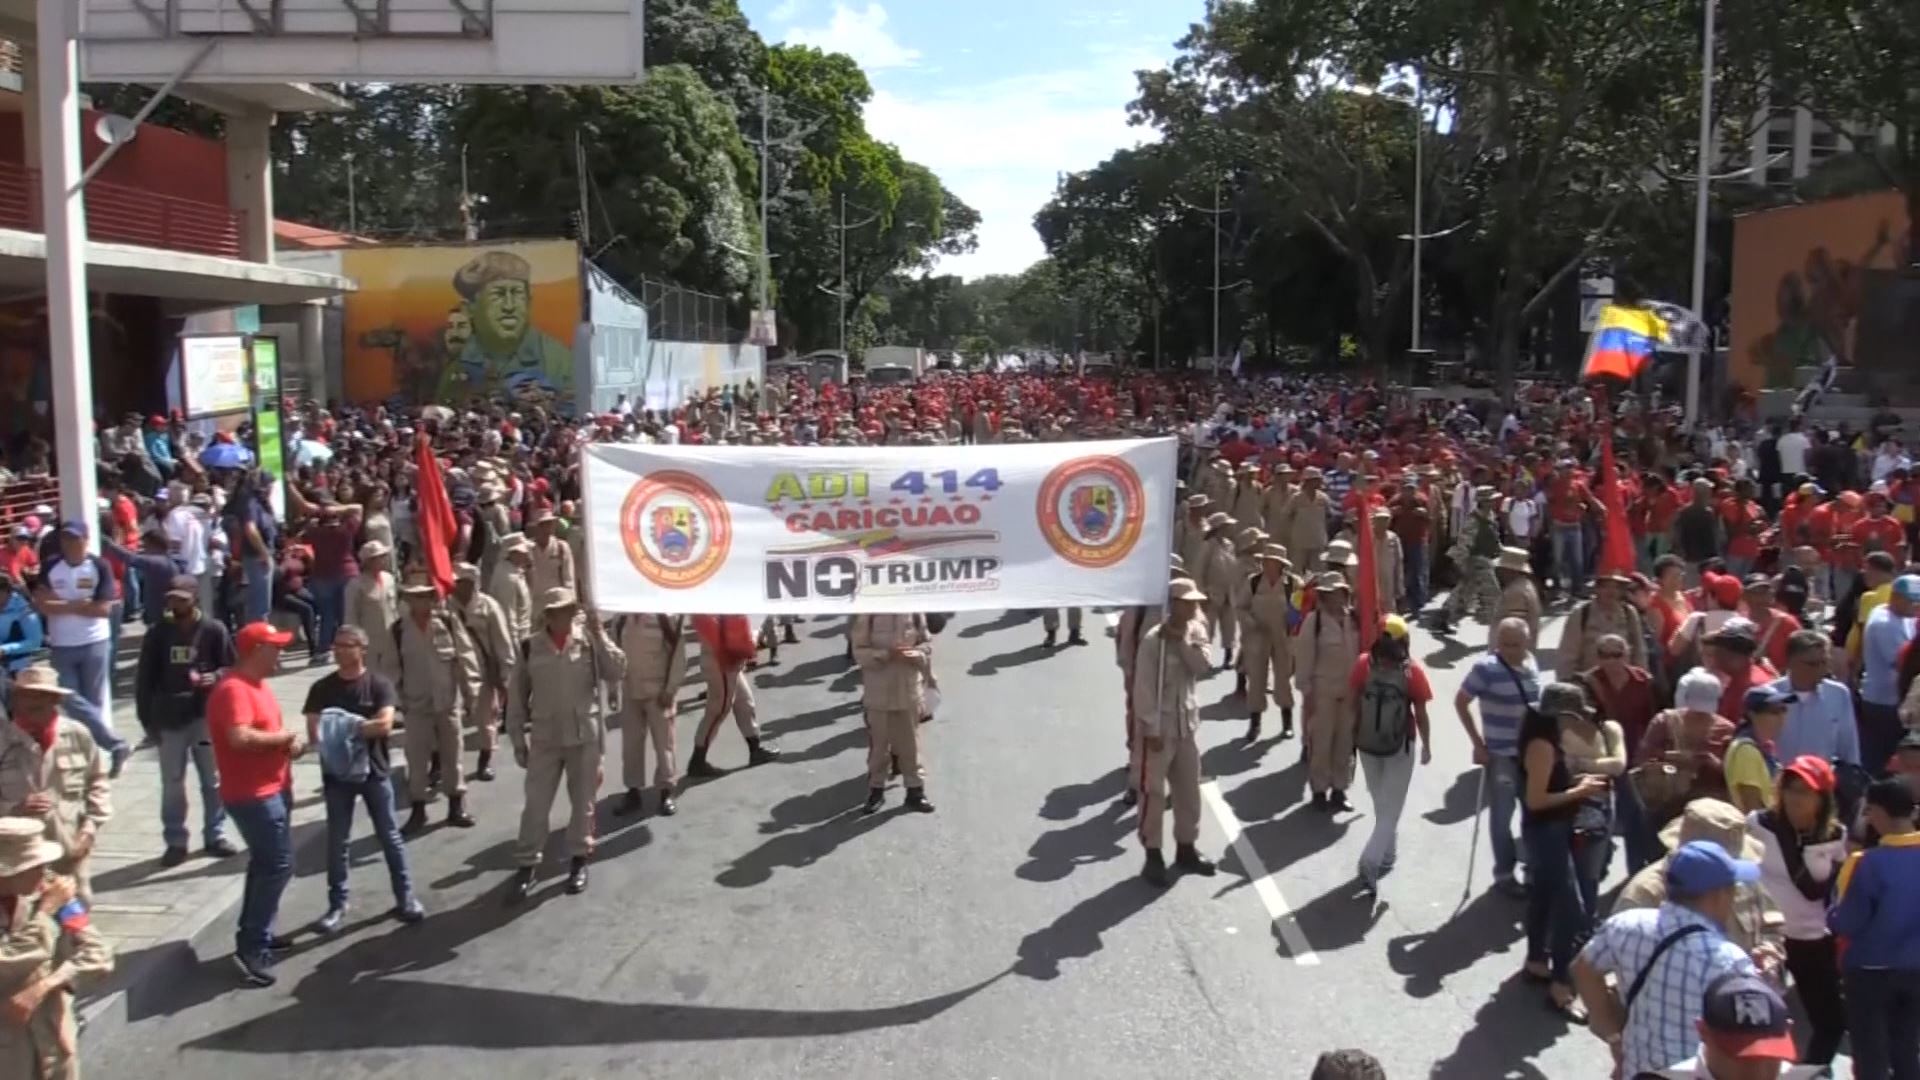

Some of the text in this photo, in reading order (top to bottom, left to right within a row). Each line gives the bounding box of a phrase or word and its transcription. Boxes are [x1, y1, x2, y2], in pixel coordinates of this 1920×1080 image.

[765, 468, 1004, 501] ADI 414
[785, 504, 982, 533] CARICUAO
[864, 558, 999, 584] TRUMP
